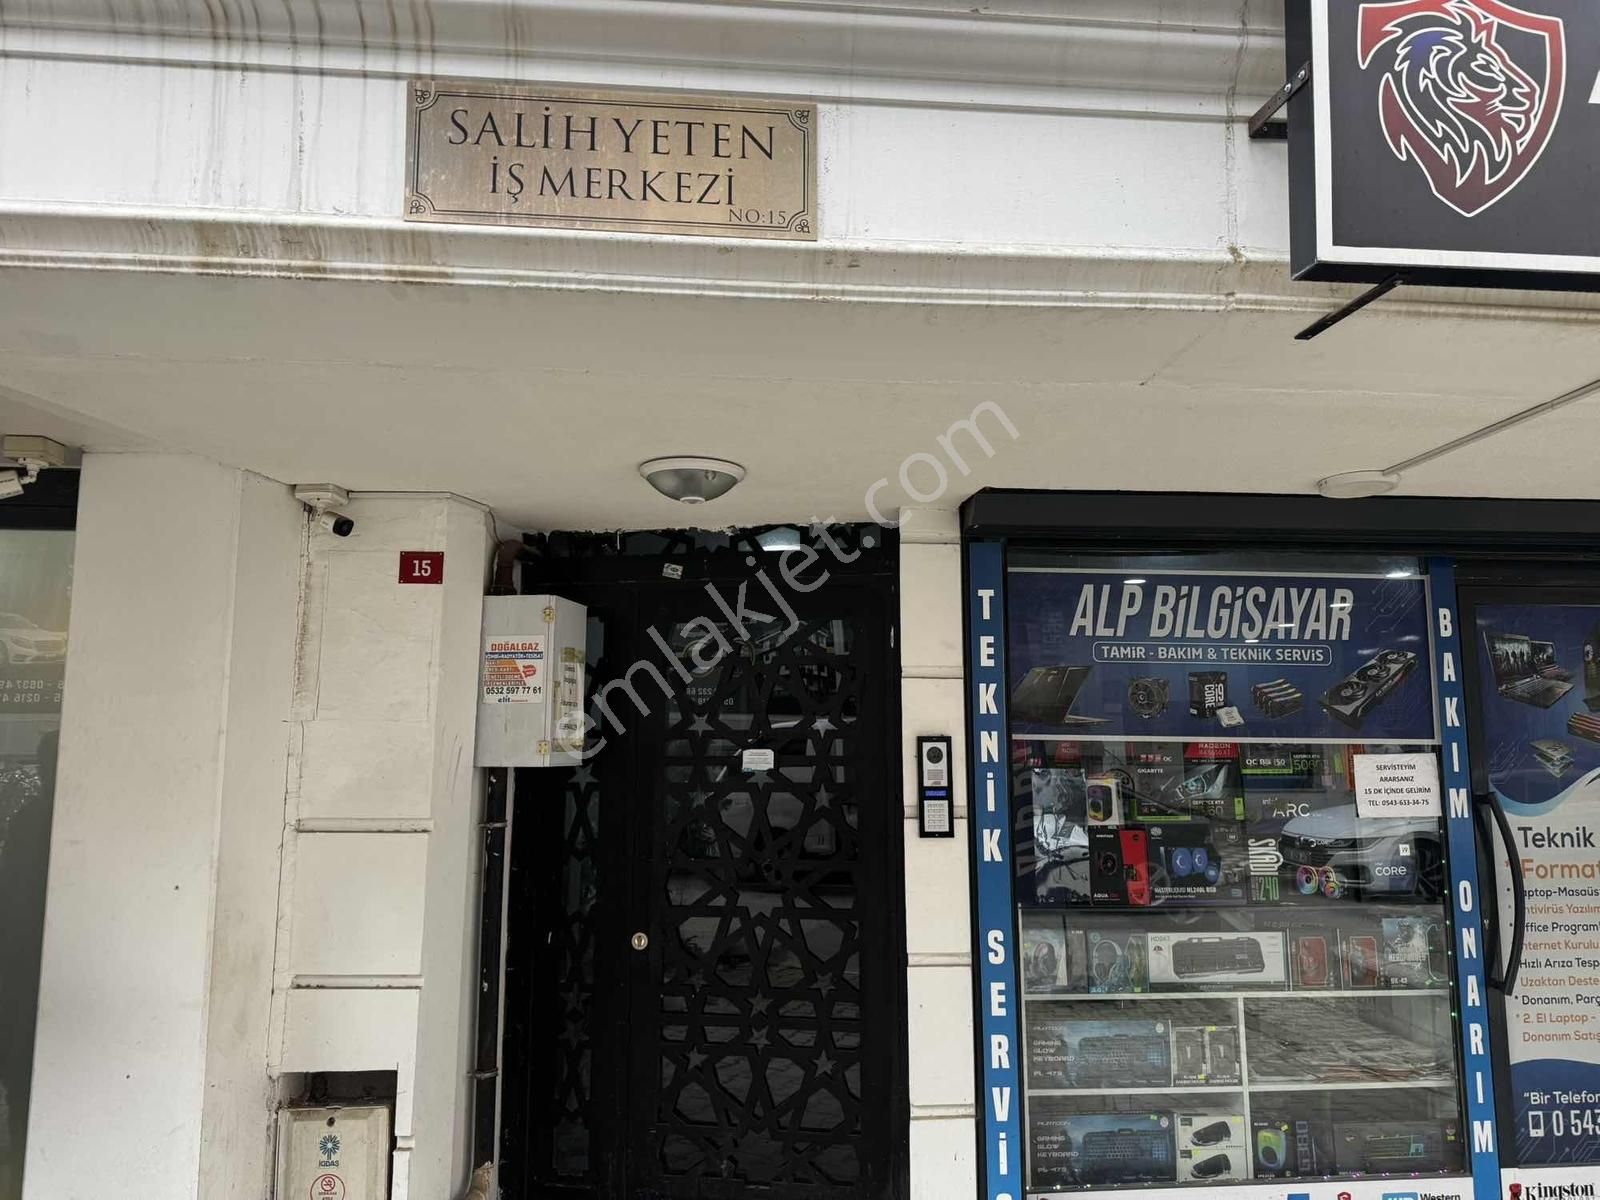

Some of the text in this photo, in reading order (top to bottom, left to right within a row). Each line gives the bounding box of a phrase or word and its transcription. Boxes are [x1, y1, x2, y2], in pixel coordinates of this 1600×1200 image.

[489, 156, 736, 206] İŞ MERKEZİ
[728, 208, 786, 225] NO:15
[412, 560, 432, 577] 15
[1069, 584, 1144, 637] ALP
[1158, 646, 1202, 660] BAKIM
[1207, 647, 1217, 660] &
[486, 686, 542, 695] 0532 597 77 61
[1272, 803, 1311, 818] ARC
[1517, 826, 1596, 848] Teknik
[1247, 838, 1284, 876] SKADI
[1525, 904, 1564, 914] ntivirüs
[1525, 922, 1549, 932] ffice
[1523, 940, 1561, 950] nternet
[1544, 958, 1573, 969] Arıza
[1520, 976, 1566, 987] Uzaktan
[1549, 1012, 1589, 1026] Laptop
[1523, 1031, 1571, 1042] Donanım
[1552, 1110, 1564, 1136] 0
